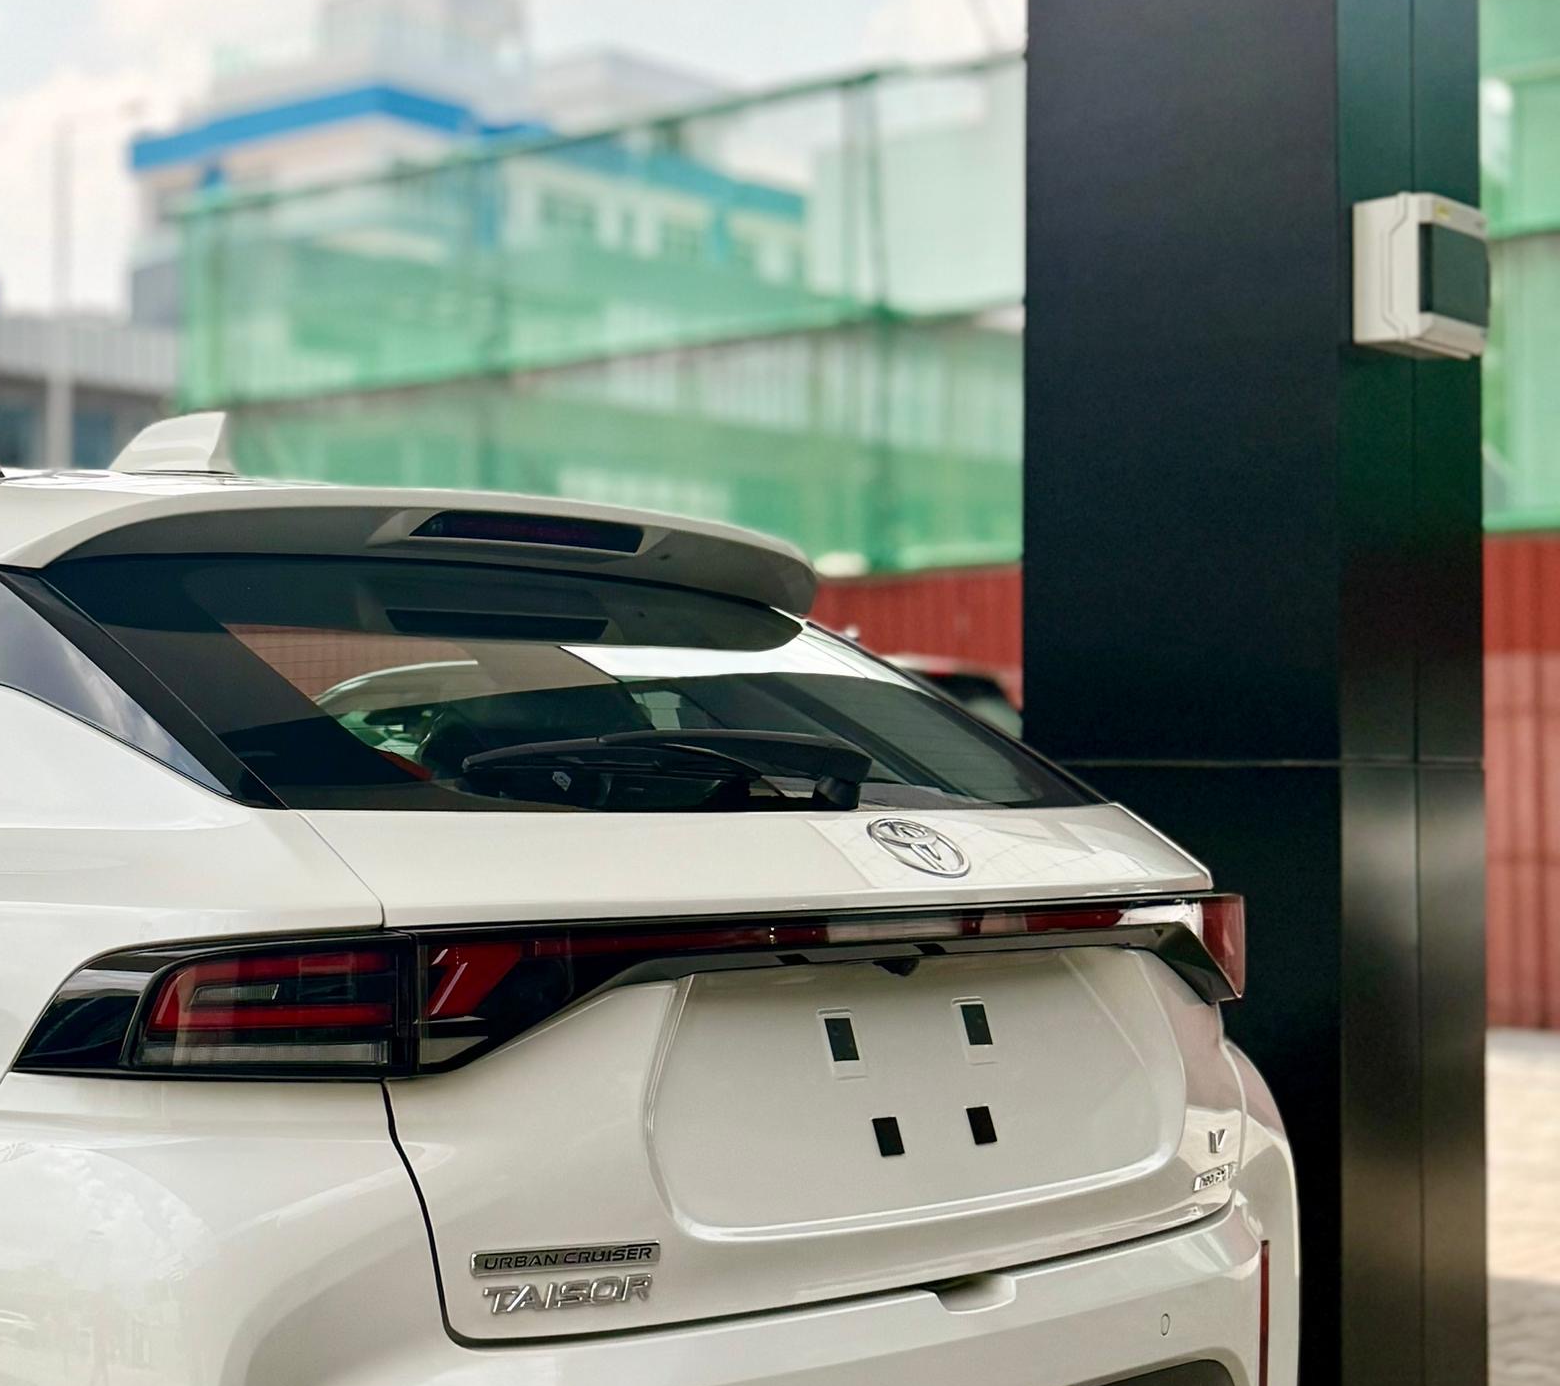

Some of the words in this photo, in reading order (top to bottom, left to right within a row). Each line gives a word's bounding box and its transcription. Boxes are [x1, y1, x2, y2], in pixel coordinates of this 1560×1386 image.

[1207, 1128, 1228, 1154] V
[484, 1253, 558, 1270] URBAN
[563, 1247, 652, 1263] CRUISER
[482, 1272, 653, 1314] TAISOR
